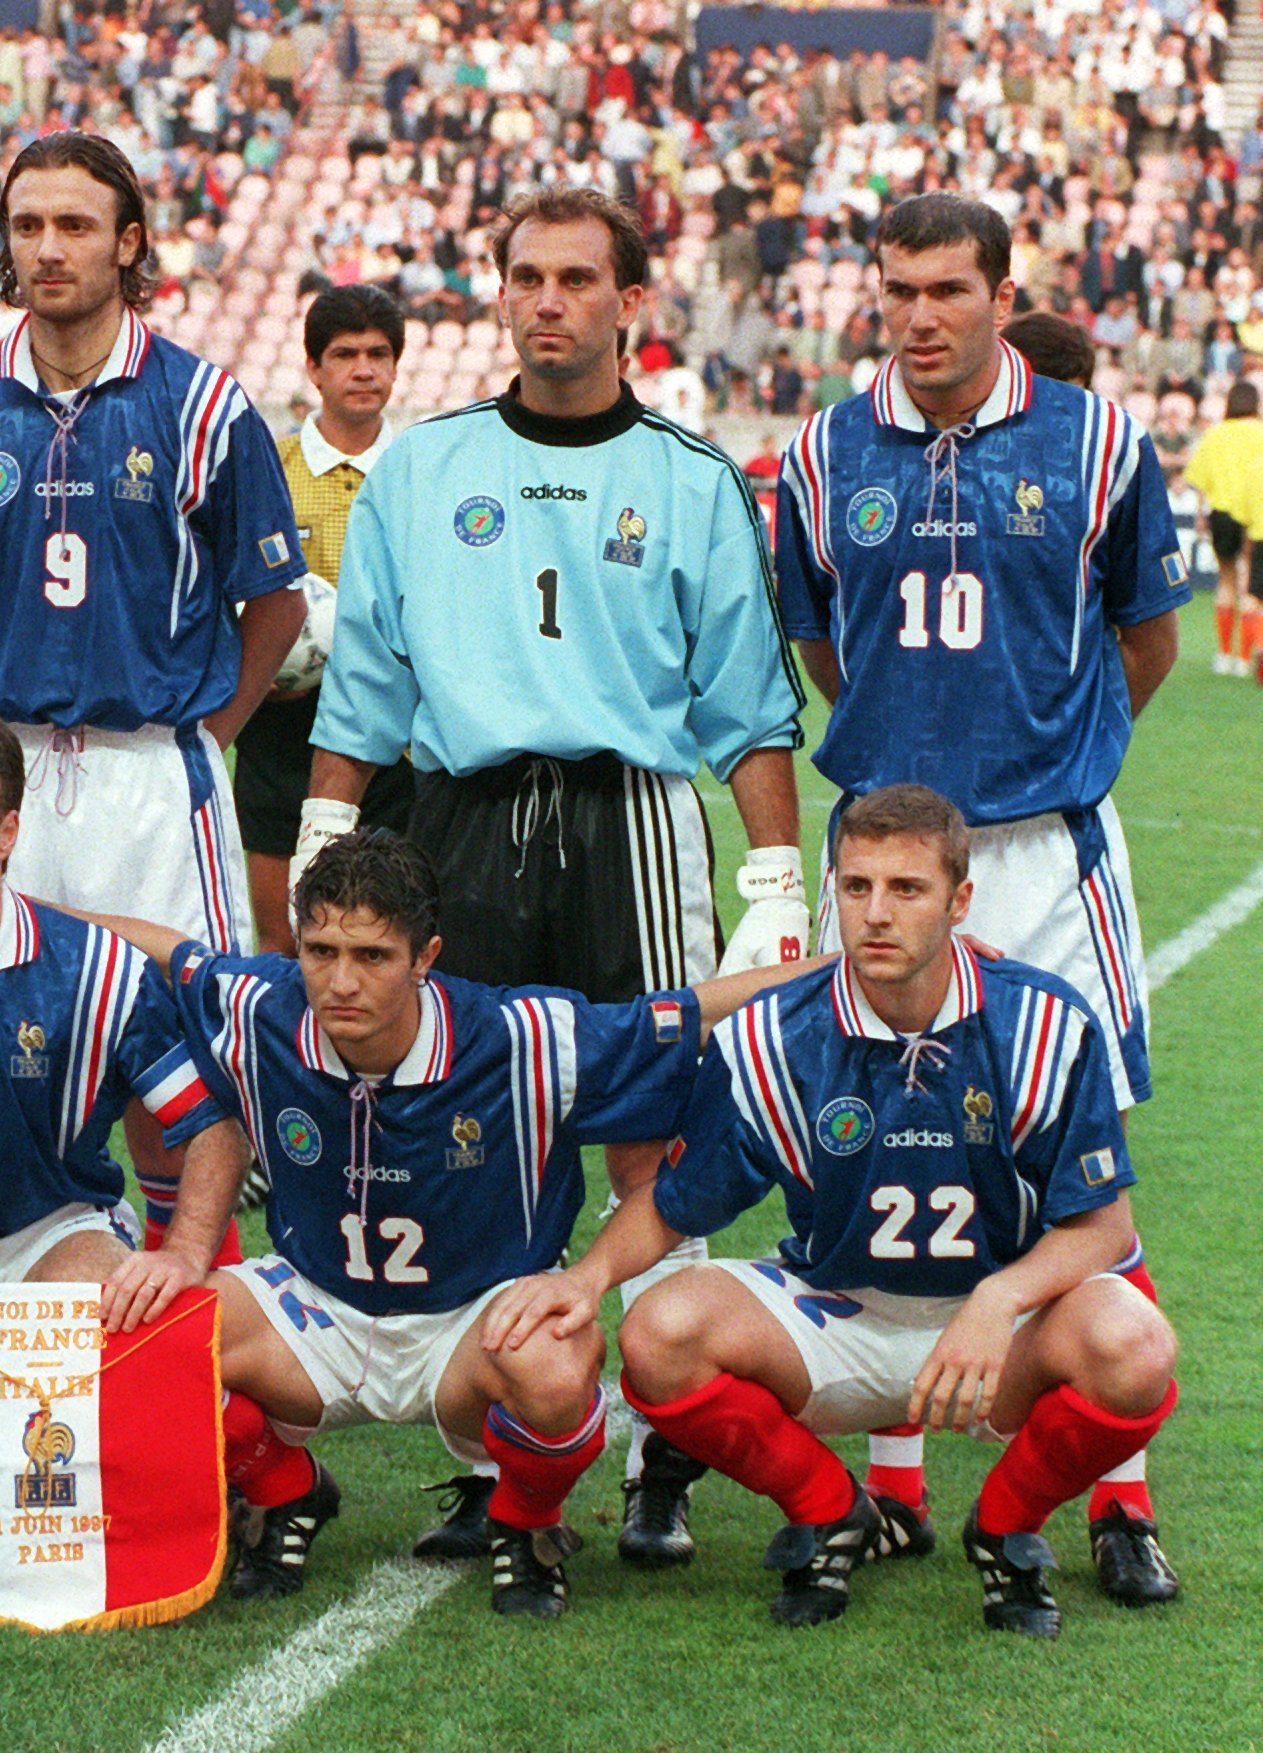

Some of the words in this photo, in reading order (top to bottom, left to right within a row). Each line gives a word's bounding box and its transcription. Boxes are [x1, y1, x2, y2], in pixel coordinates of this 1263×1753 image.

[520, 484, 588, 502] adidas
[44, 531, 88, 608] 9
[536, 568, 562, 640] 1
[898, 569, 984, 650] 10
[822, 1102, 866, 1123] TOURNOI
[883, 1127, 954, 1148] adidas
[869, 1184, 977, 1260] 22
[339, 1213, 429, 1283] 12
[35, 1301, 65, 1320] DE
[9, 1514, 63, 1535] JUIN
[69, 1513, 113, 1533] 1997
[18, 1542, 85, 1565] PARIS
